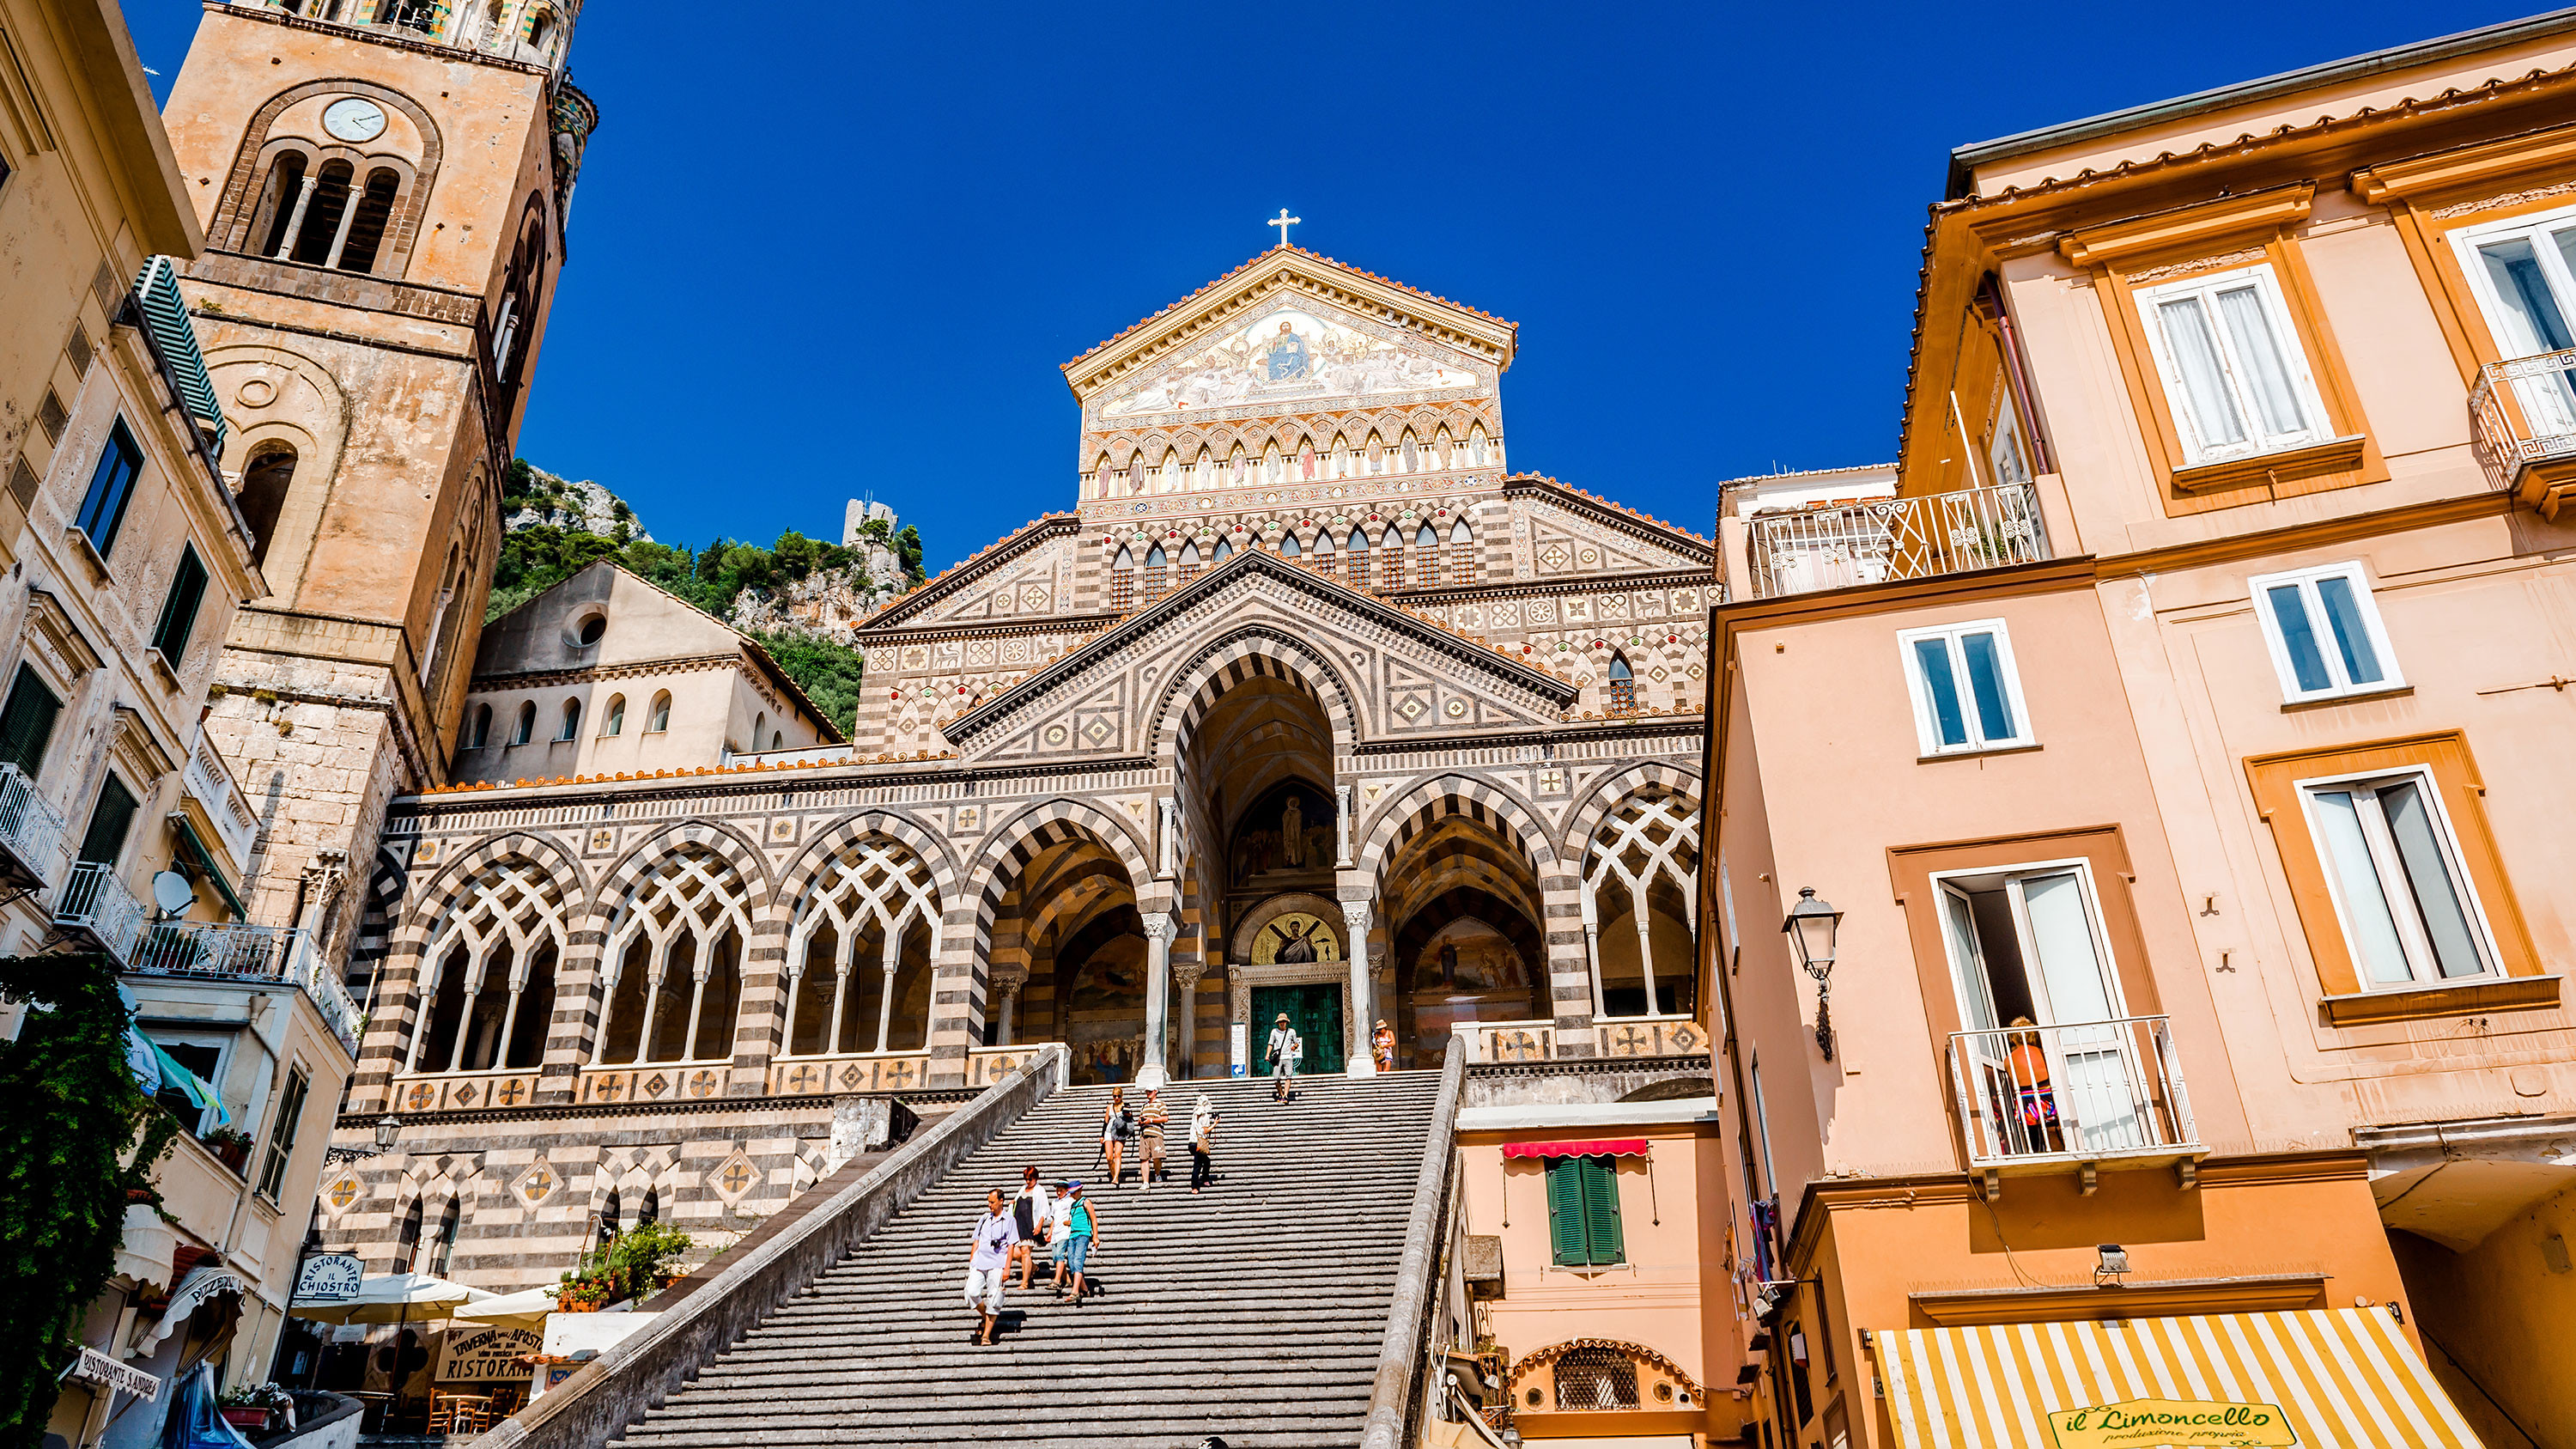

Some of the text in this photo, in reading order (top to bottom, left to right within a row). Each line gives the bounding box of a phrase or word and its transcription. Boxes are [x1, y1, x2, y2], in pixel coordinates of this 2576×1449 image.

[305, 1257, 357, 1282] RISTORANTE
[299, 1281, 359, 1293] CHIOSTRO
[453, 1330, 497, 1356] TAVERNA
[84, 1355, 125, 1384] RISTORANTE
[2066, 1406, 2270, 1432] il Limoncello
[2103, 1427, 2248, 1444] produzione propria
